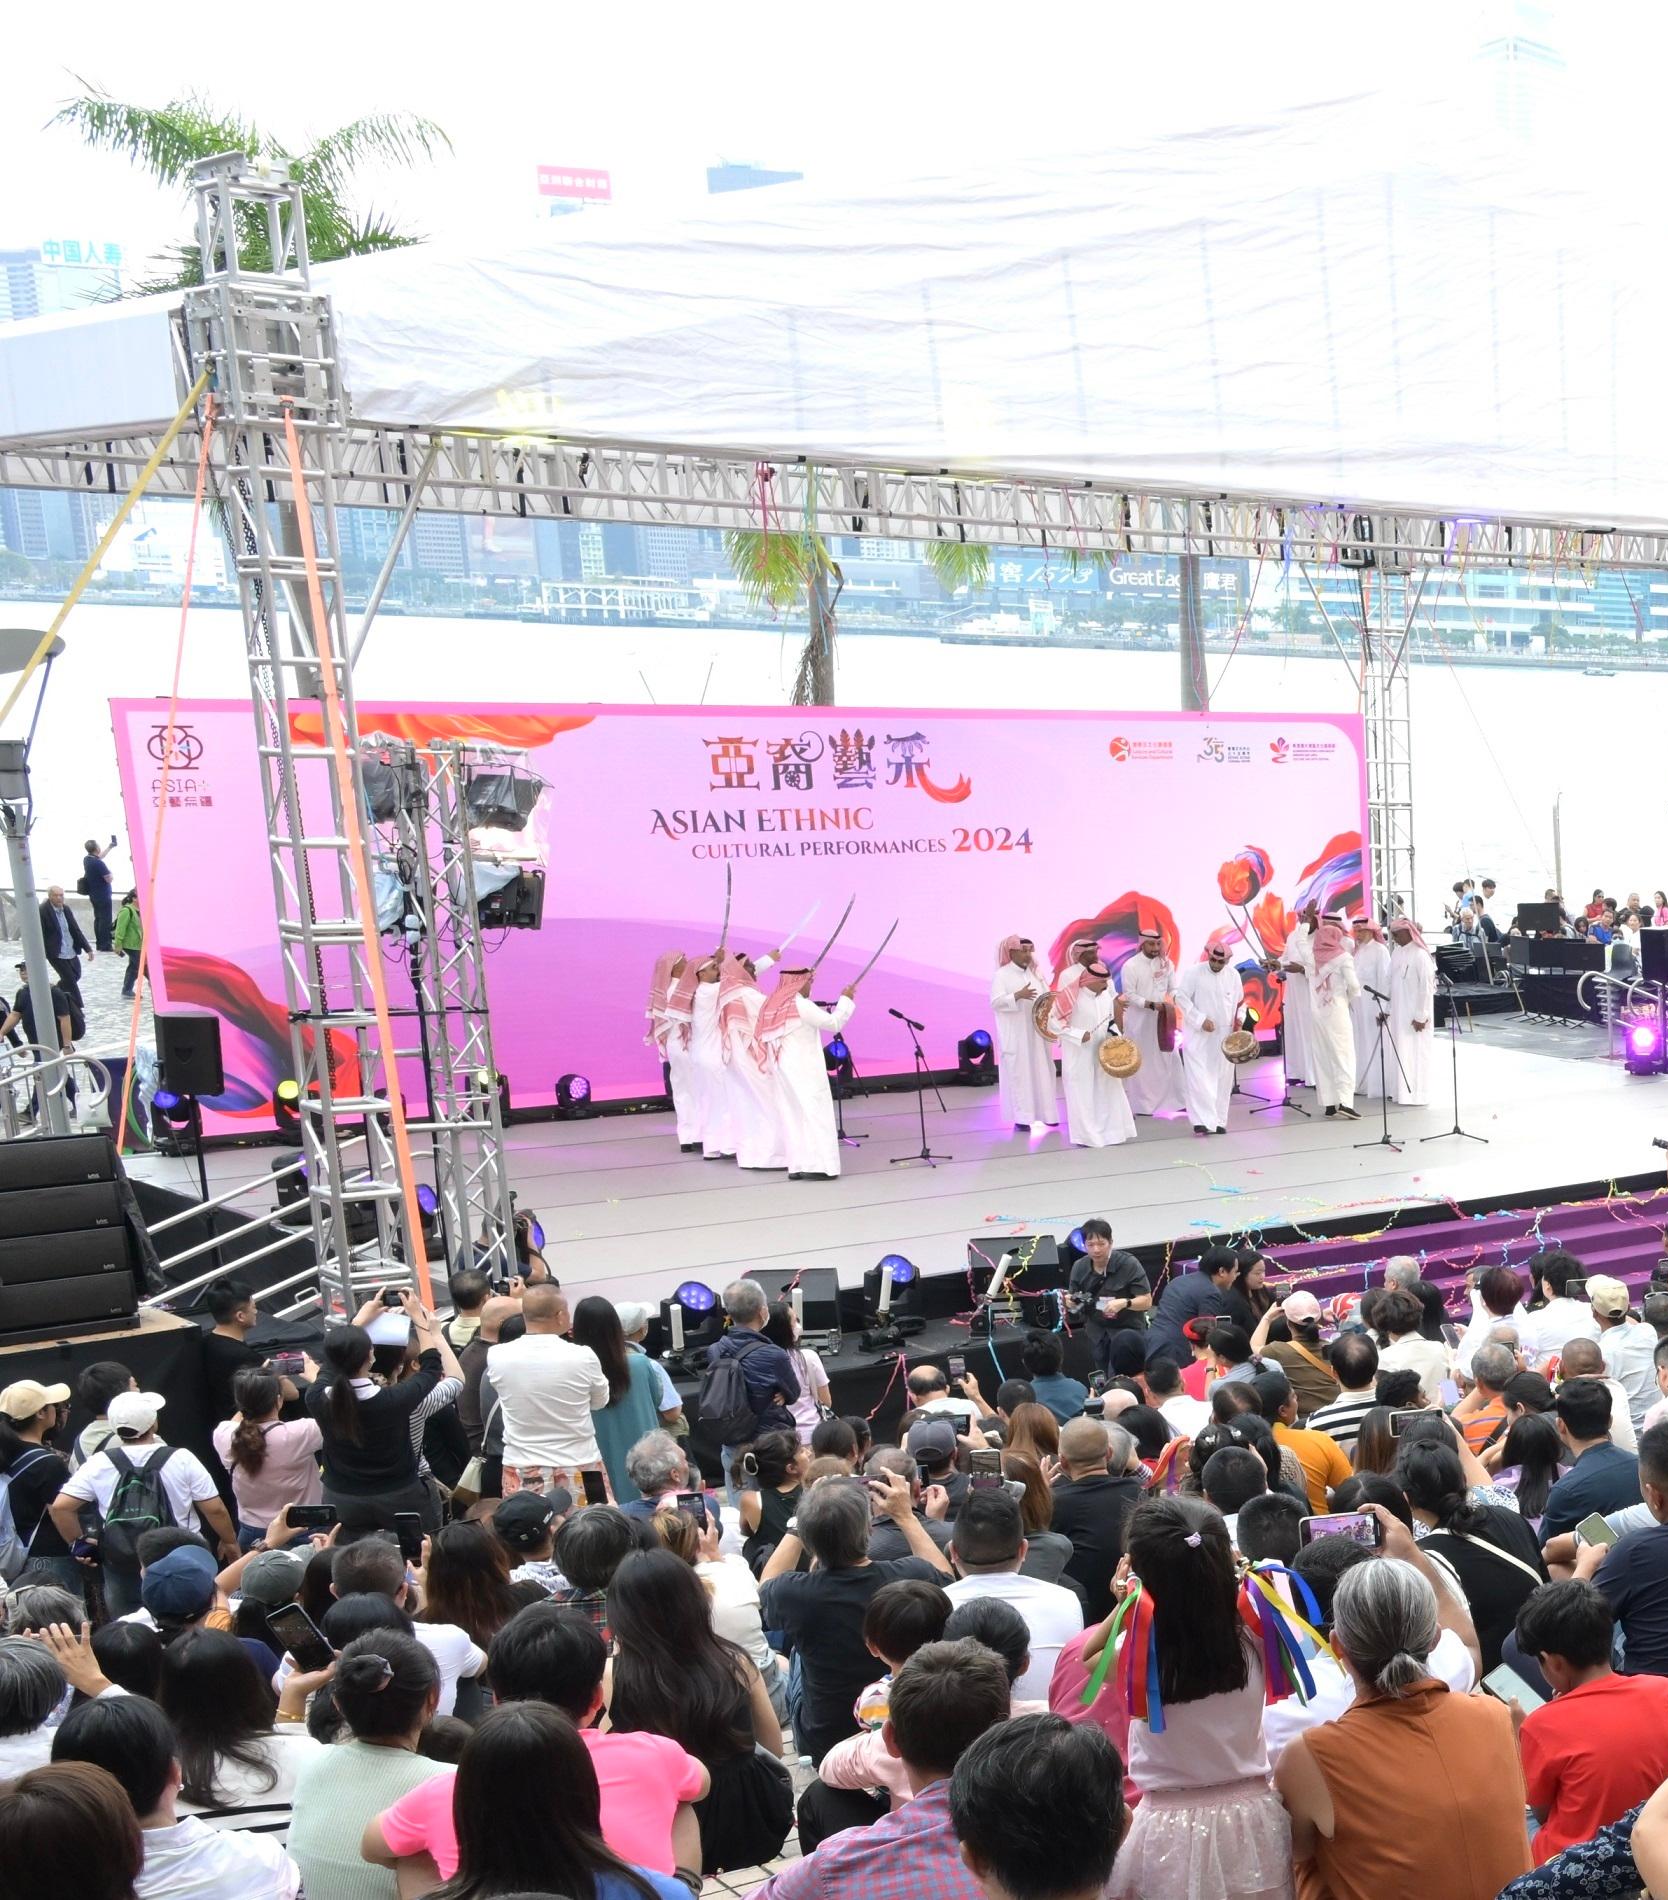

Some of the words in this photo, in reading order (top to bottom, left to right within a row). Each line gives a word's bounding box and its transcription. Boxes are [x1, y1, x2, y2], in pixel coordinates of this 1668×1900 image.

[1026, 566, 1093, 584] 1573
[1109, 567, 1152, 586] Great
[1203, 572, 1237, 591] 鷹君
[702, 728, 971, 803] 亞裔藝采
[650, 809, 746, 840] ASIAN
[757, 807, 874, 833] ETHNIC
[692, 843, 795, 859] CULTURAL
[800, 838, 947, 856] PERFORMANCES
[952, 827, 1034, 854] 2024
